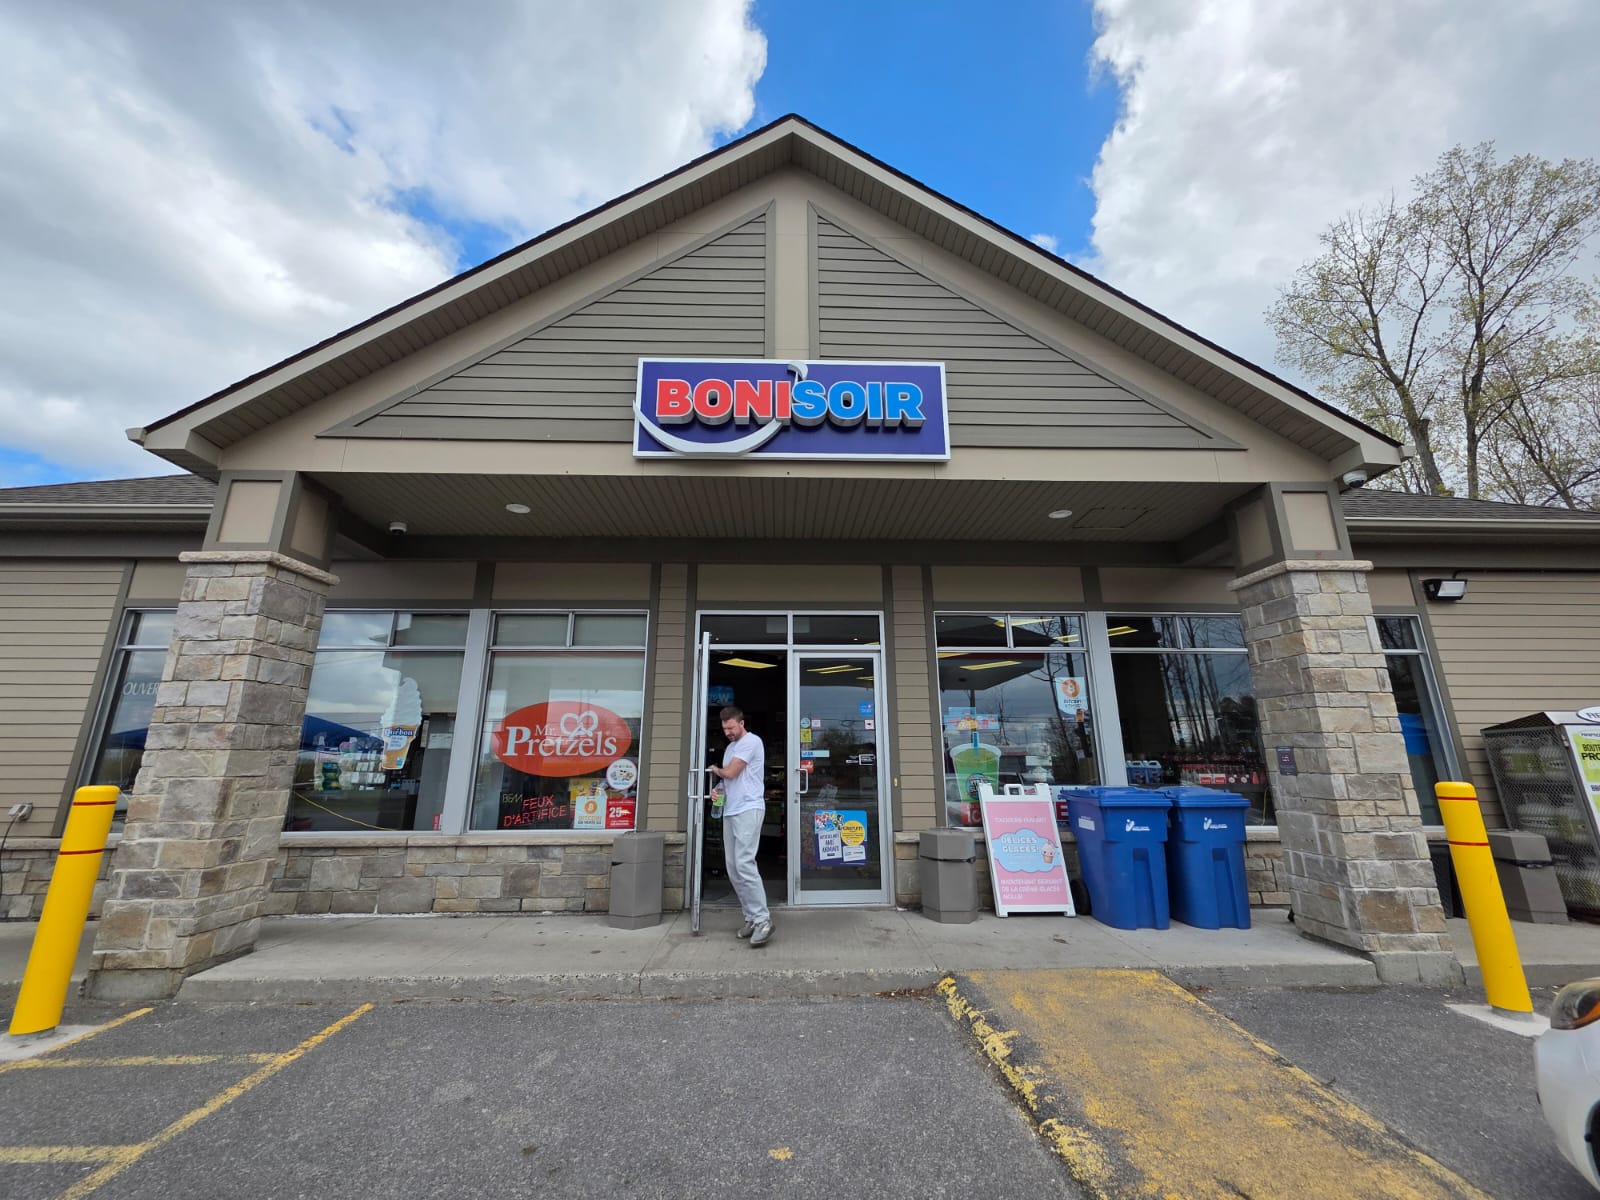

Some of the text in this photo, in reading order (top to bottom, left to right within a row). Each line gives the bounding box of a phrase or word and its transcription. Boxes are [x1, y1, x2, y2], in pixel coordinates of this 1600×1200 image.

[534, 725, 556, 737] Mr.
[502, 726, 617, 757] Pretzels
[522, 794, 554, 810] FEUX
[503, 805, 567, 827] D'ARTIFICE
